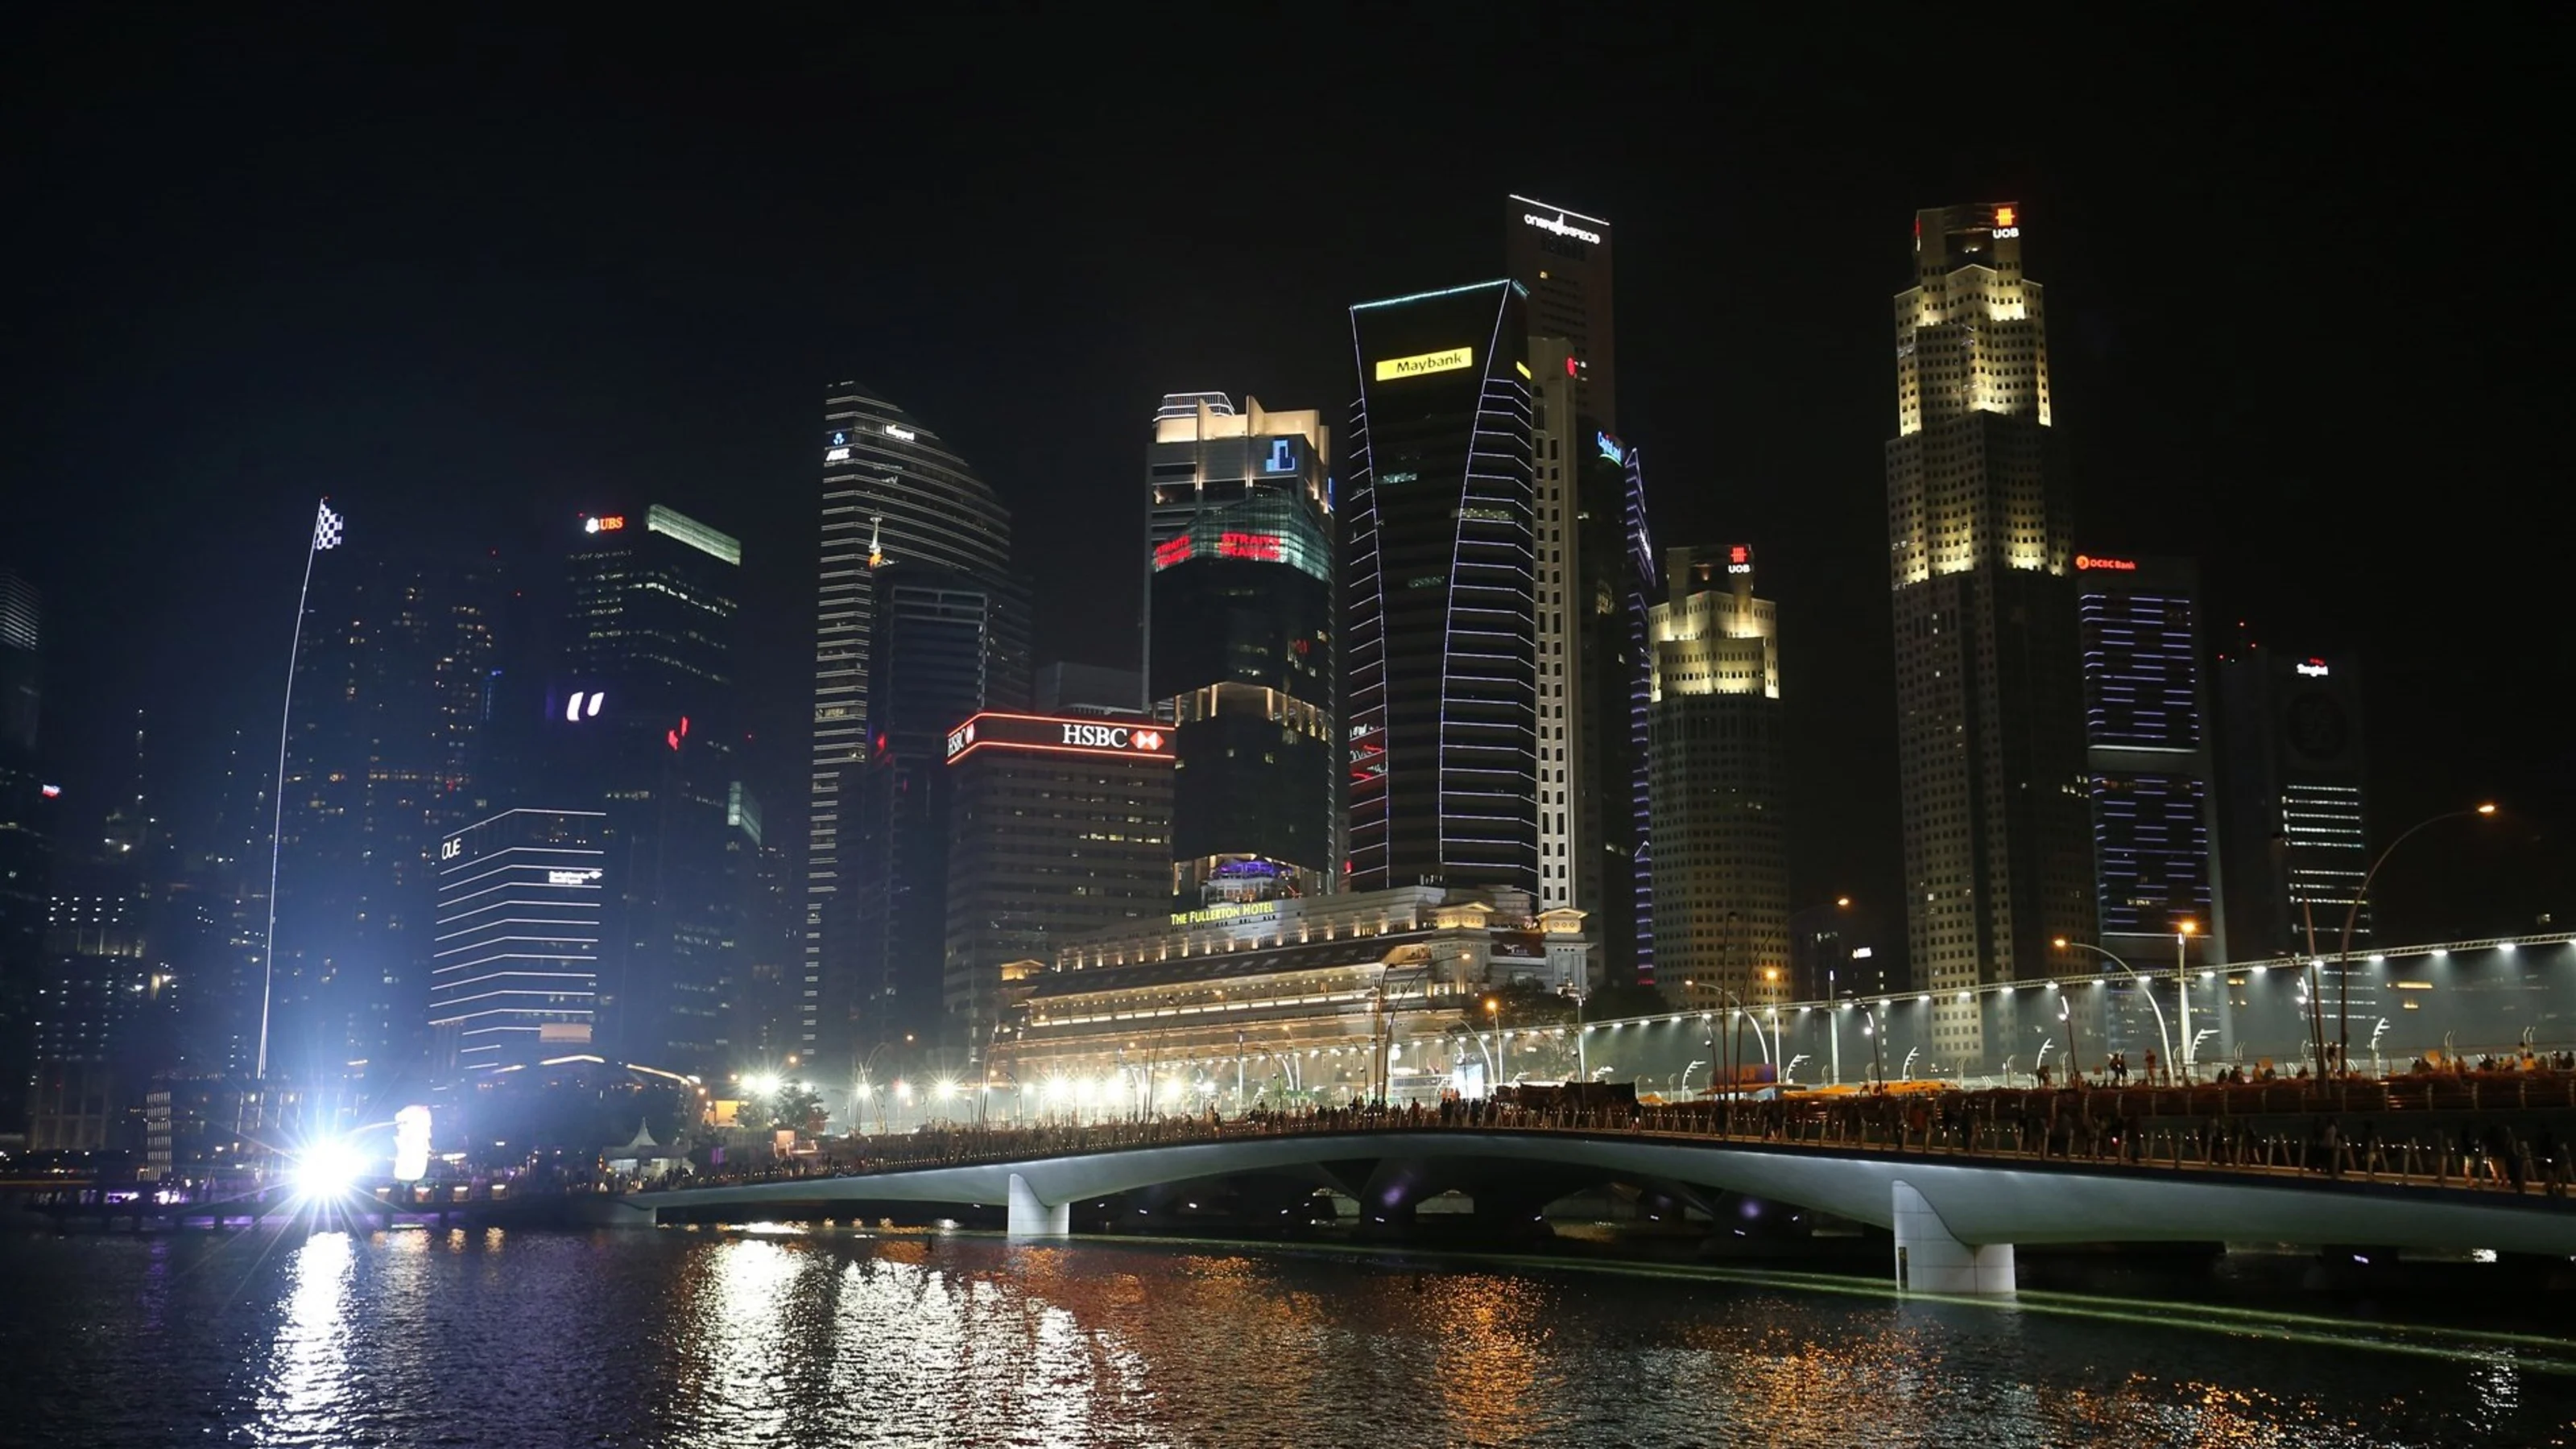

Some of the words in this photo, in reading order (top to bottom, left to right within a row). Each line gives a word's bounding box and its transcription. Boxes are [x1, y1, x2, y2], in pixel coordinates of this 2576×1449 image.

[1992, 227, 2020, 239] UOB
[1396, 352, 1462, 374] Maybank
[599, 516, 624, 530] UBS
[1221, 532, 1280, 547] STRAITS
[1727, 564, 1751, 573] UOB
[2090, 559, 2115, 568] OCBC
[2115, 560, 2136, 570] Bank
[1062, 723, 1128, 749] HSBC
[441, 838, 461, 860] OUE
[1170, 913, 1187, 925] THE
[1189, 906, 1240, 923] FULLERTON
[1243, 902, 1274, 916] HOTEL
